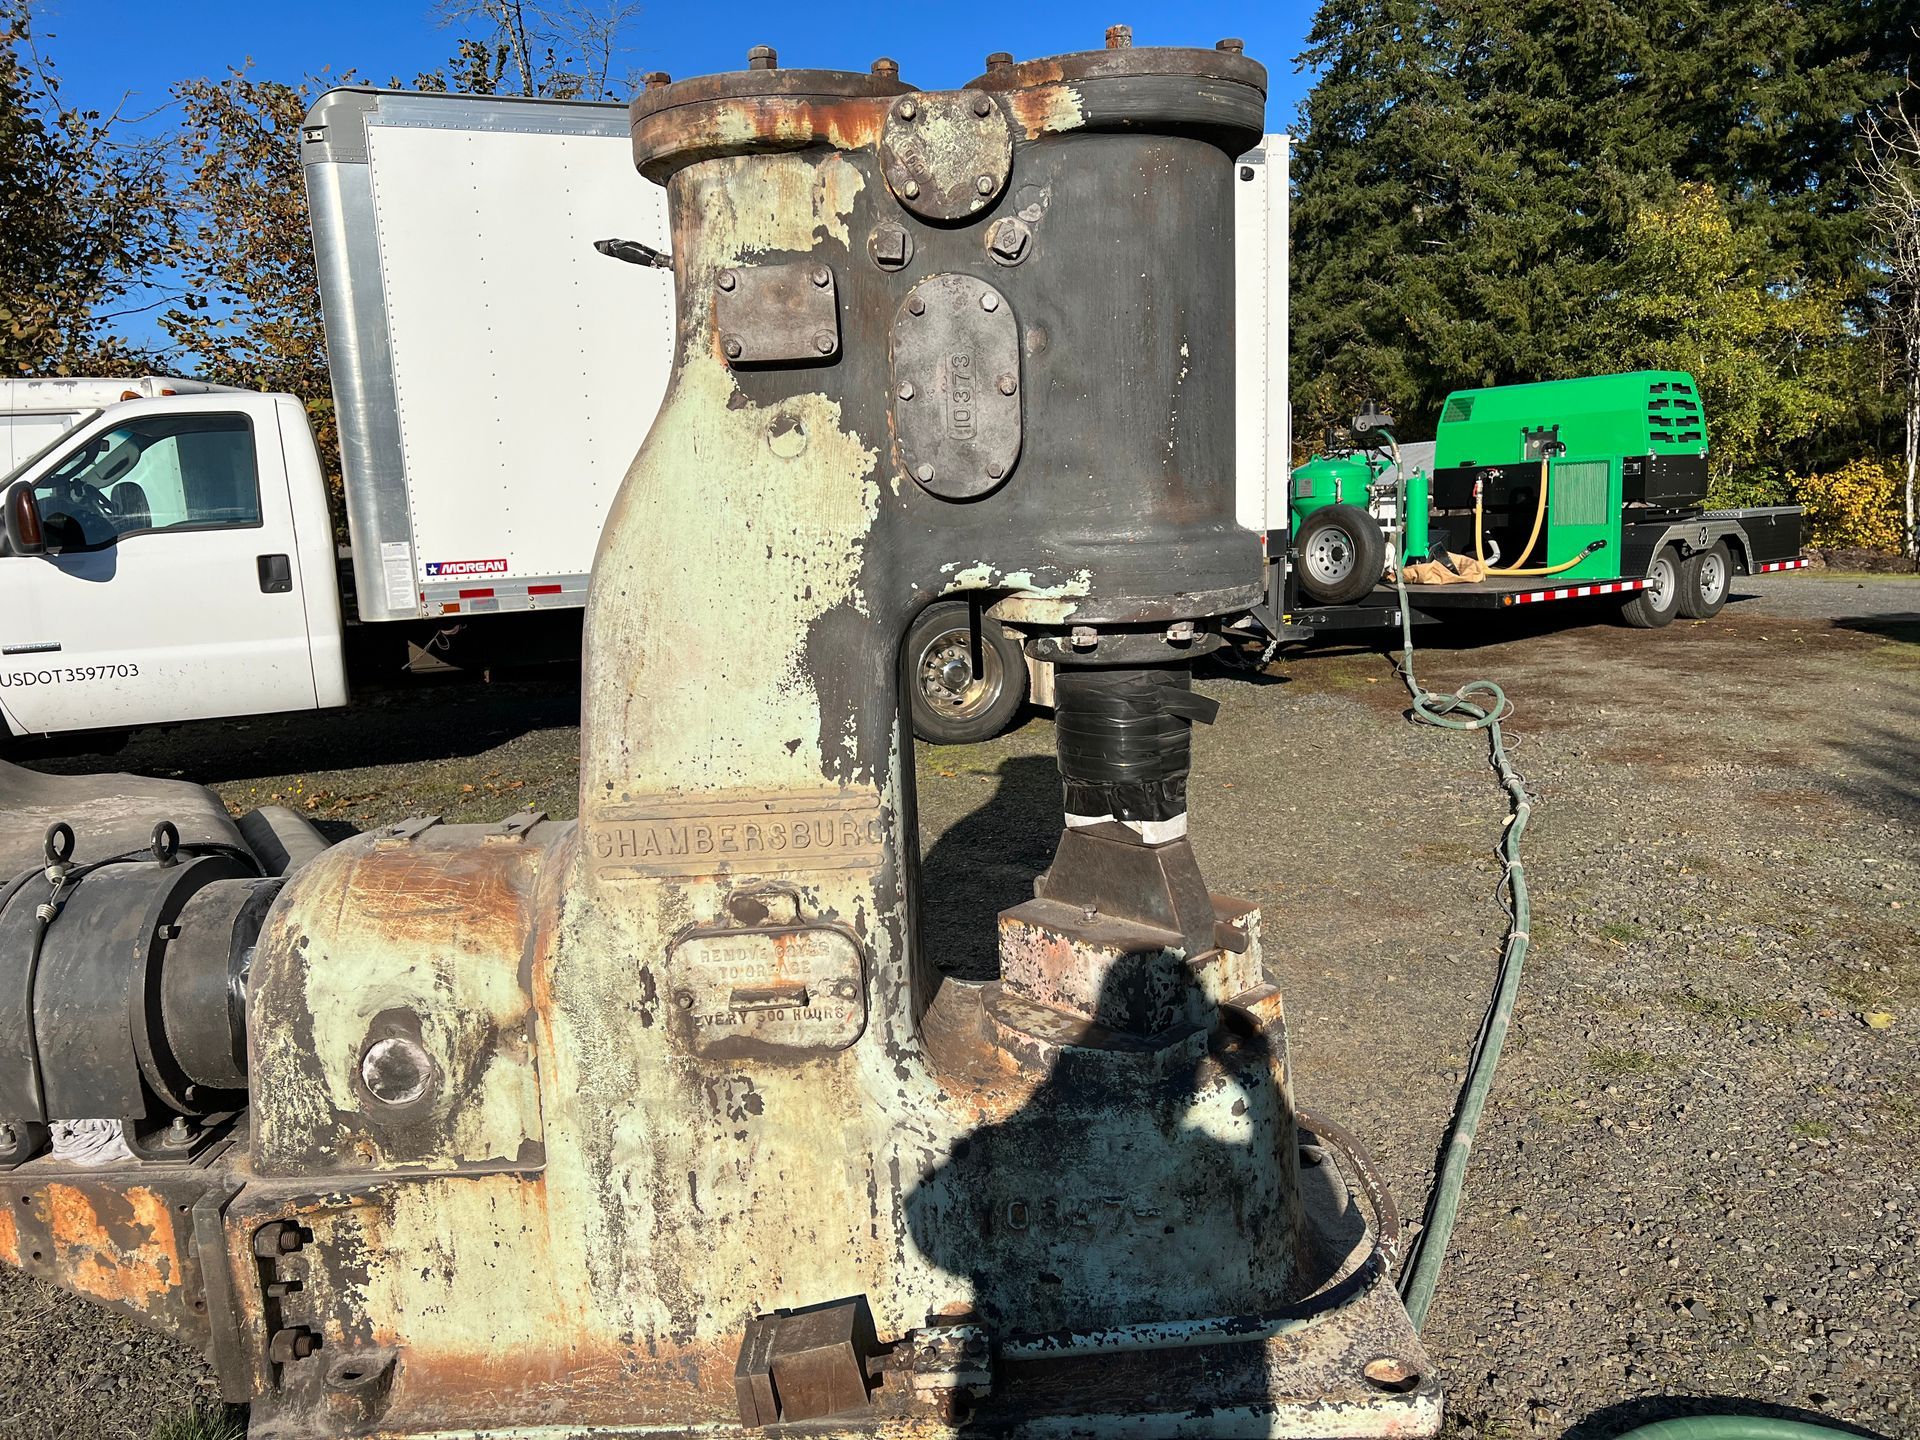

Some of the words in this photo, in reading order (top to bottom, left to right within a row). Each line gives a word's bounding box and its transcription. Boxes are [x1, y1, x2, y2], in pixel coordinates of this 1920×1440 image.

[952, 354, 971, 428] 10373
[441, 561, 505, 574] MORGAN
[596, 819, 883, 858] CHAMBERSBURG
[701, 944, 768, 963] REMOVE
[719, 965, 739, 979] TO
[746, 960, 812, 978] GREASE
[695, 1012, 748, 1025] EVERY
[793, 1007, 844, 1022] HOURS
